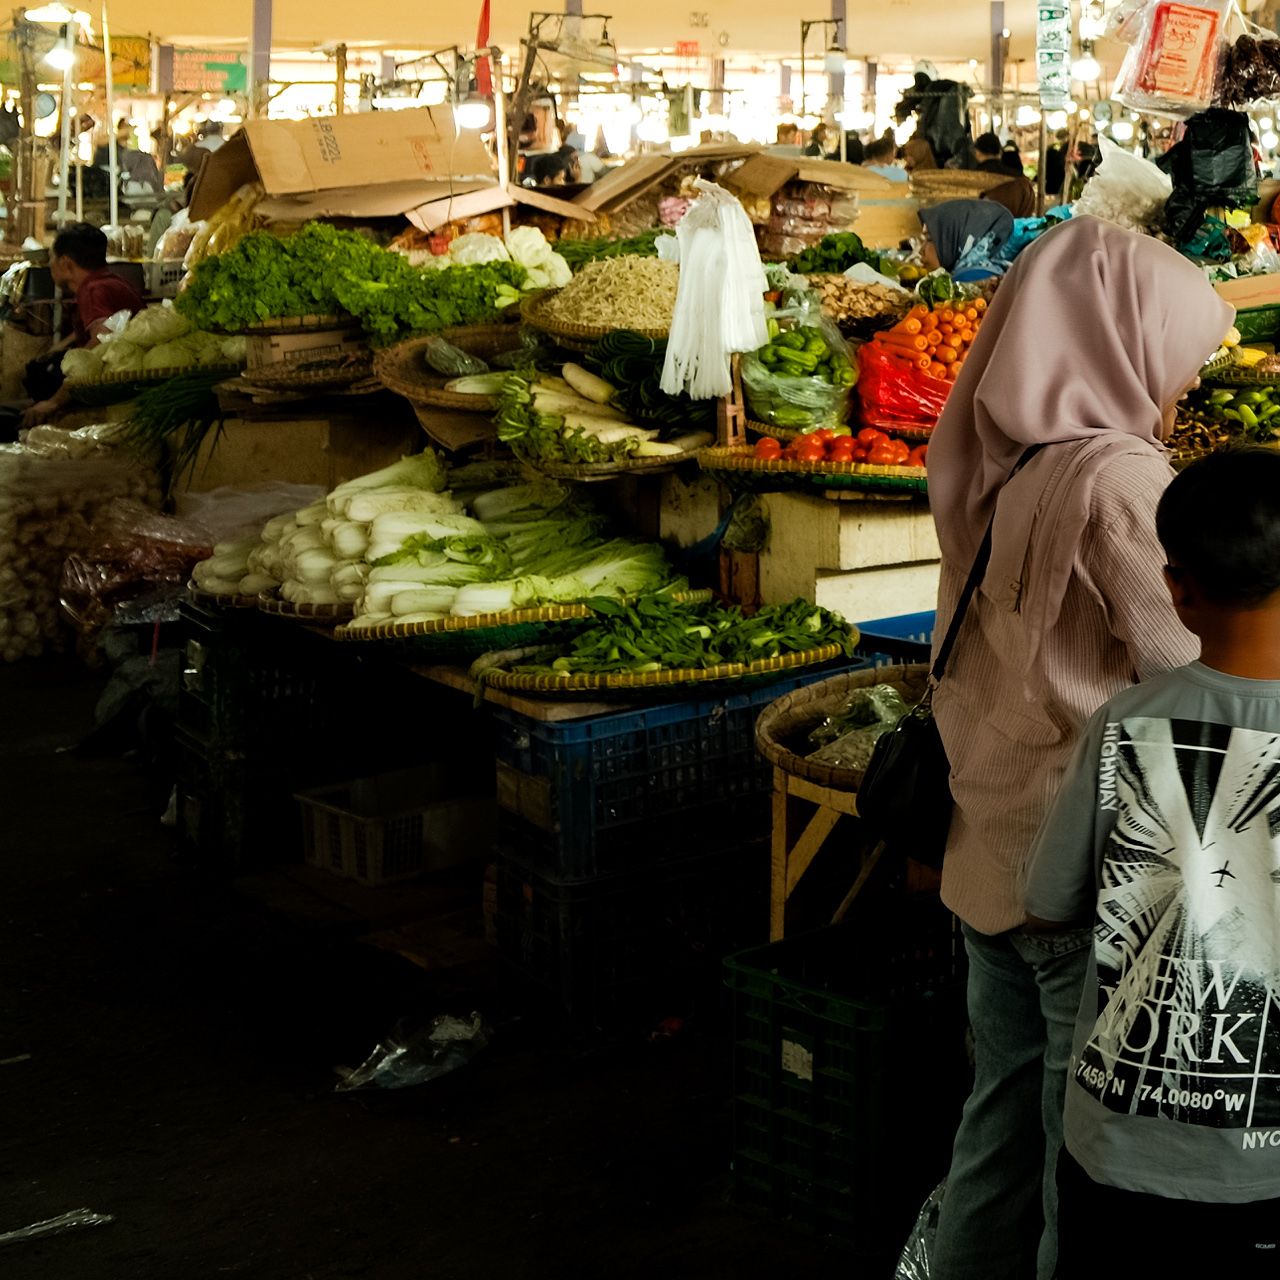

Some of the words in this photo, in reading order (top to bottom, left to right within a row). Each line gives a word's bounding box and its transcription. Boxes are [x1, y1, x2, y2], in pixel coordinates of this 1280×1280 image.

[1100, 722, 1120, 811] HIGHWAY
[1115, 941, 1247, 1010] NEW
[1100, 985, 1257, 1064] YORK
